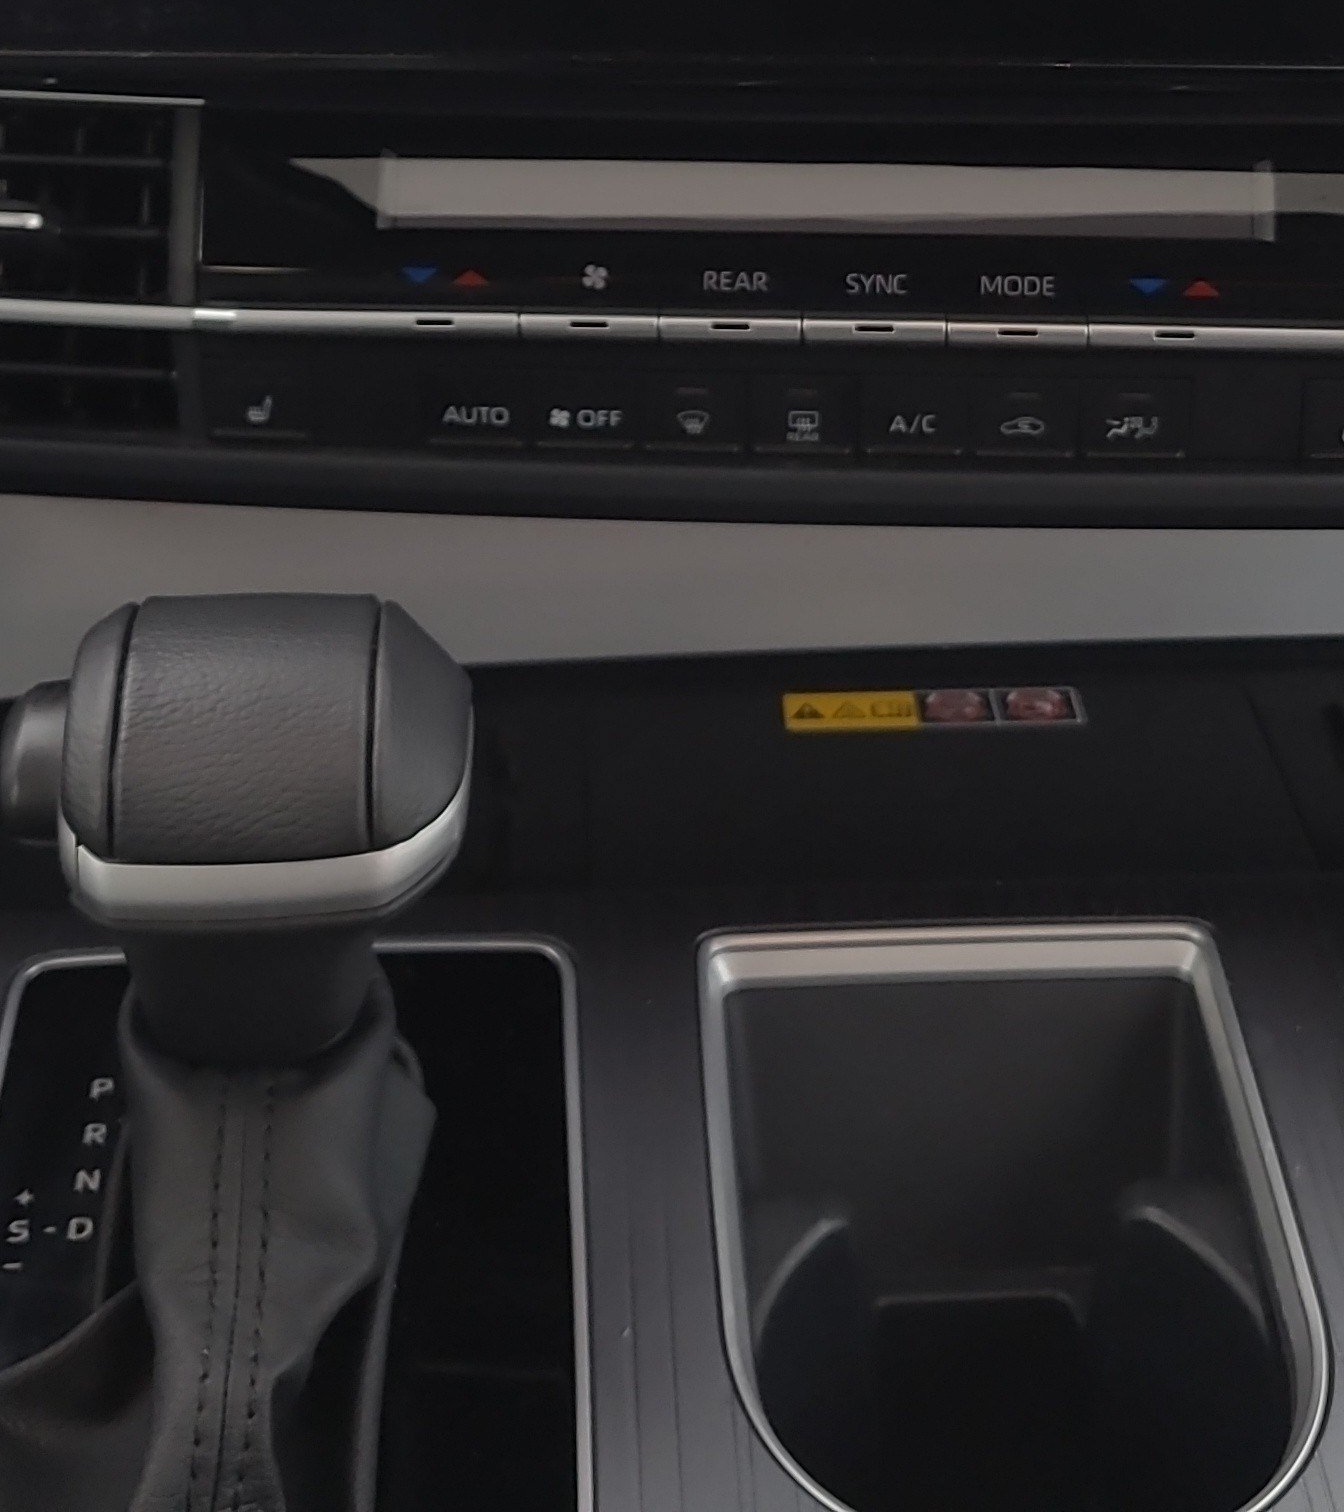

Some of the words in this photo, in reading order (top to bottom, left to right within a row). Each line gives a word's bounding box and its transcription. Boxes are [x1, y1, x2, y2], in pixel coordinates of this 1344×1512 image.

[703, 270, 770, 292] REAR
[845, 273, 908, 296] SYNC
[979, 275, 1055, 297] MODE
[442, 405, 511, 427] AUTO
[576, 409, 623, 429] OFF
[889, 414, 938, 434] A/C
[89, 1077, 115, 1101] P
[82, 1123, 107, 1145] R
[74, 1168, 101, 1193] N
[67, 1216, 94, 1241] D
